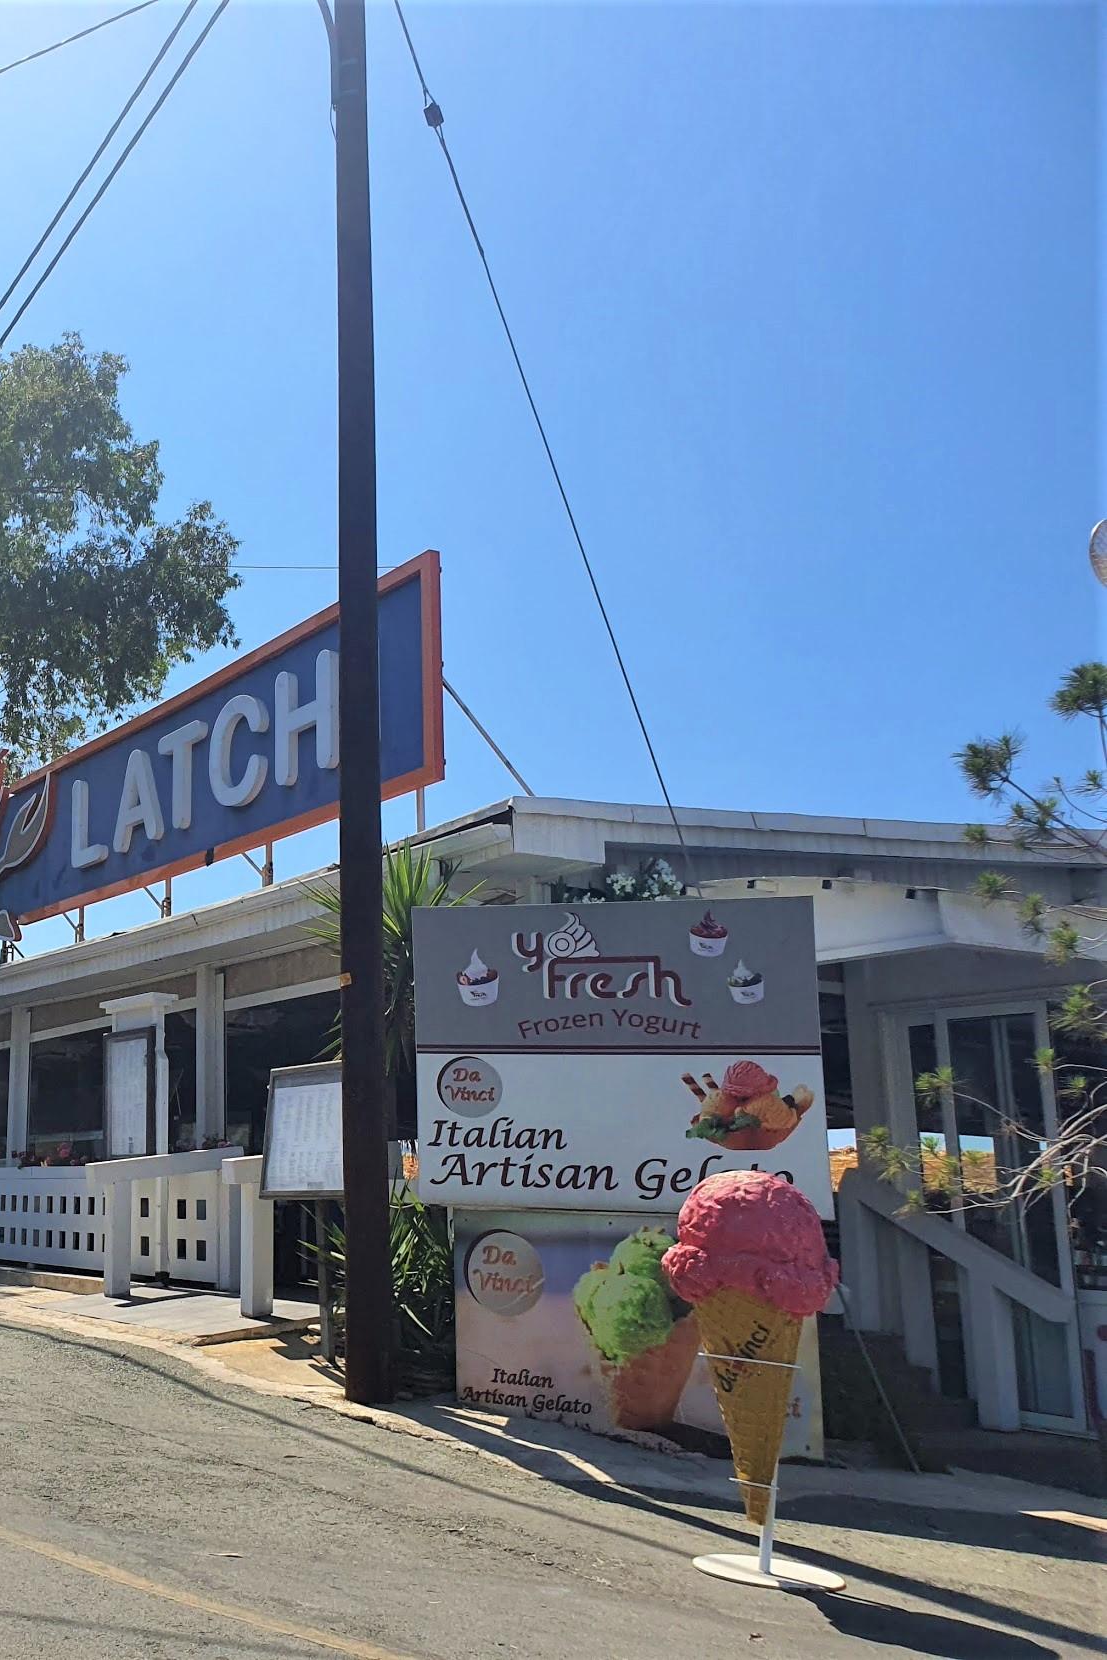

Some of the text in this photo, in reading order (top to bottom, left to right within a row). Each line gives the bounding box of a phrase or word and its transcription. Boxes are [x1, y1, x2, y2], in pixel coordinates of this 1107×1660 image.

[517, 1008, 701, 1040] Frozen Yogurt
[452, 1067, 482, 1083] Da
[444, 1084, 496, 1103] Vinci
[427, 1116, 568, 1151] Italian
[429, 1153, 794, 1201] Artisan Gel
[482, 1245, 517, 1266] Da
[472, 1268, 536, 1296] Vinci
[491, 1368, 554, 1389] Italian
[459, 1387, 593, 1416] Artisan Gelato
